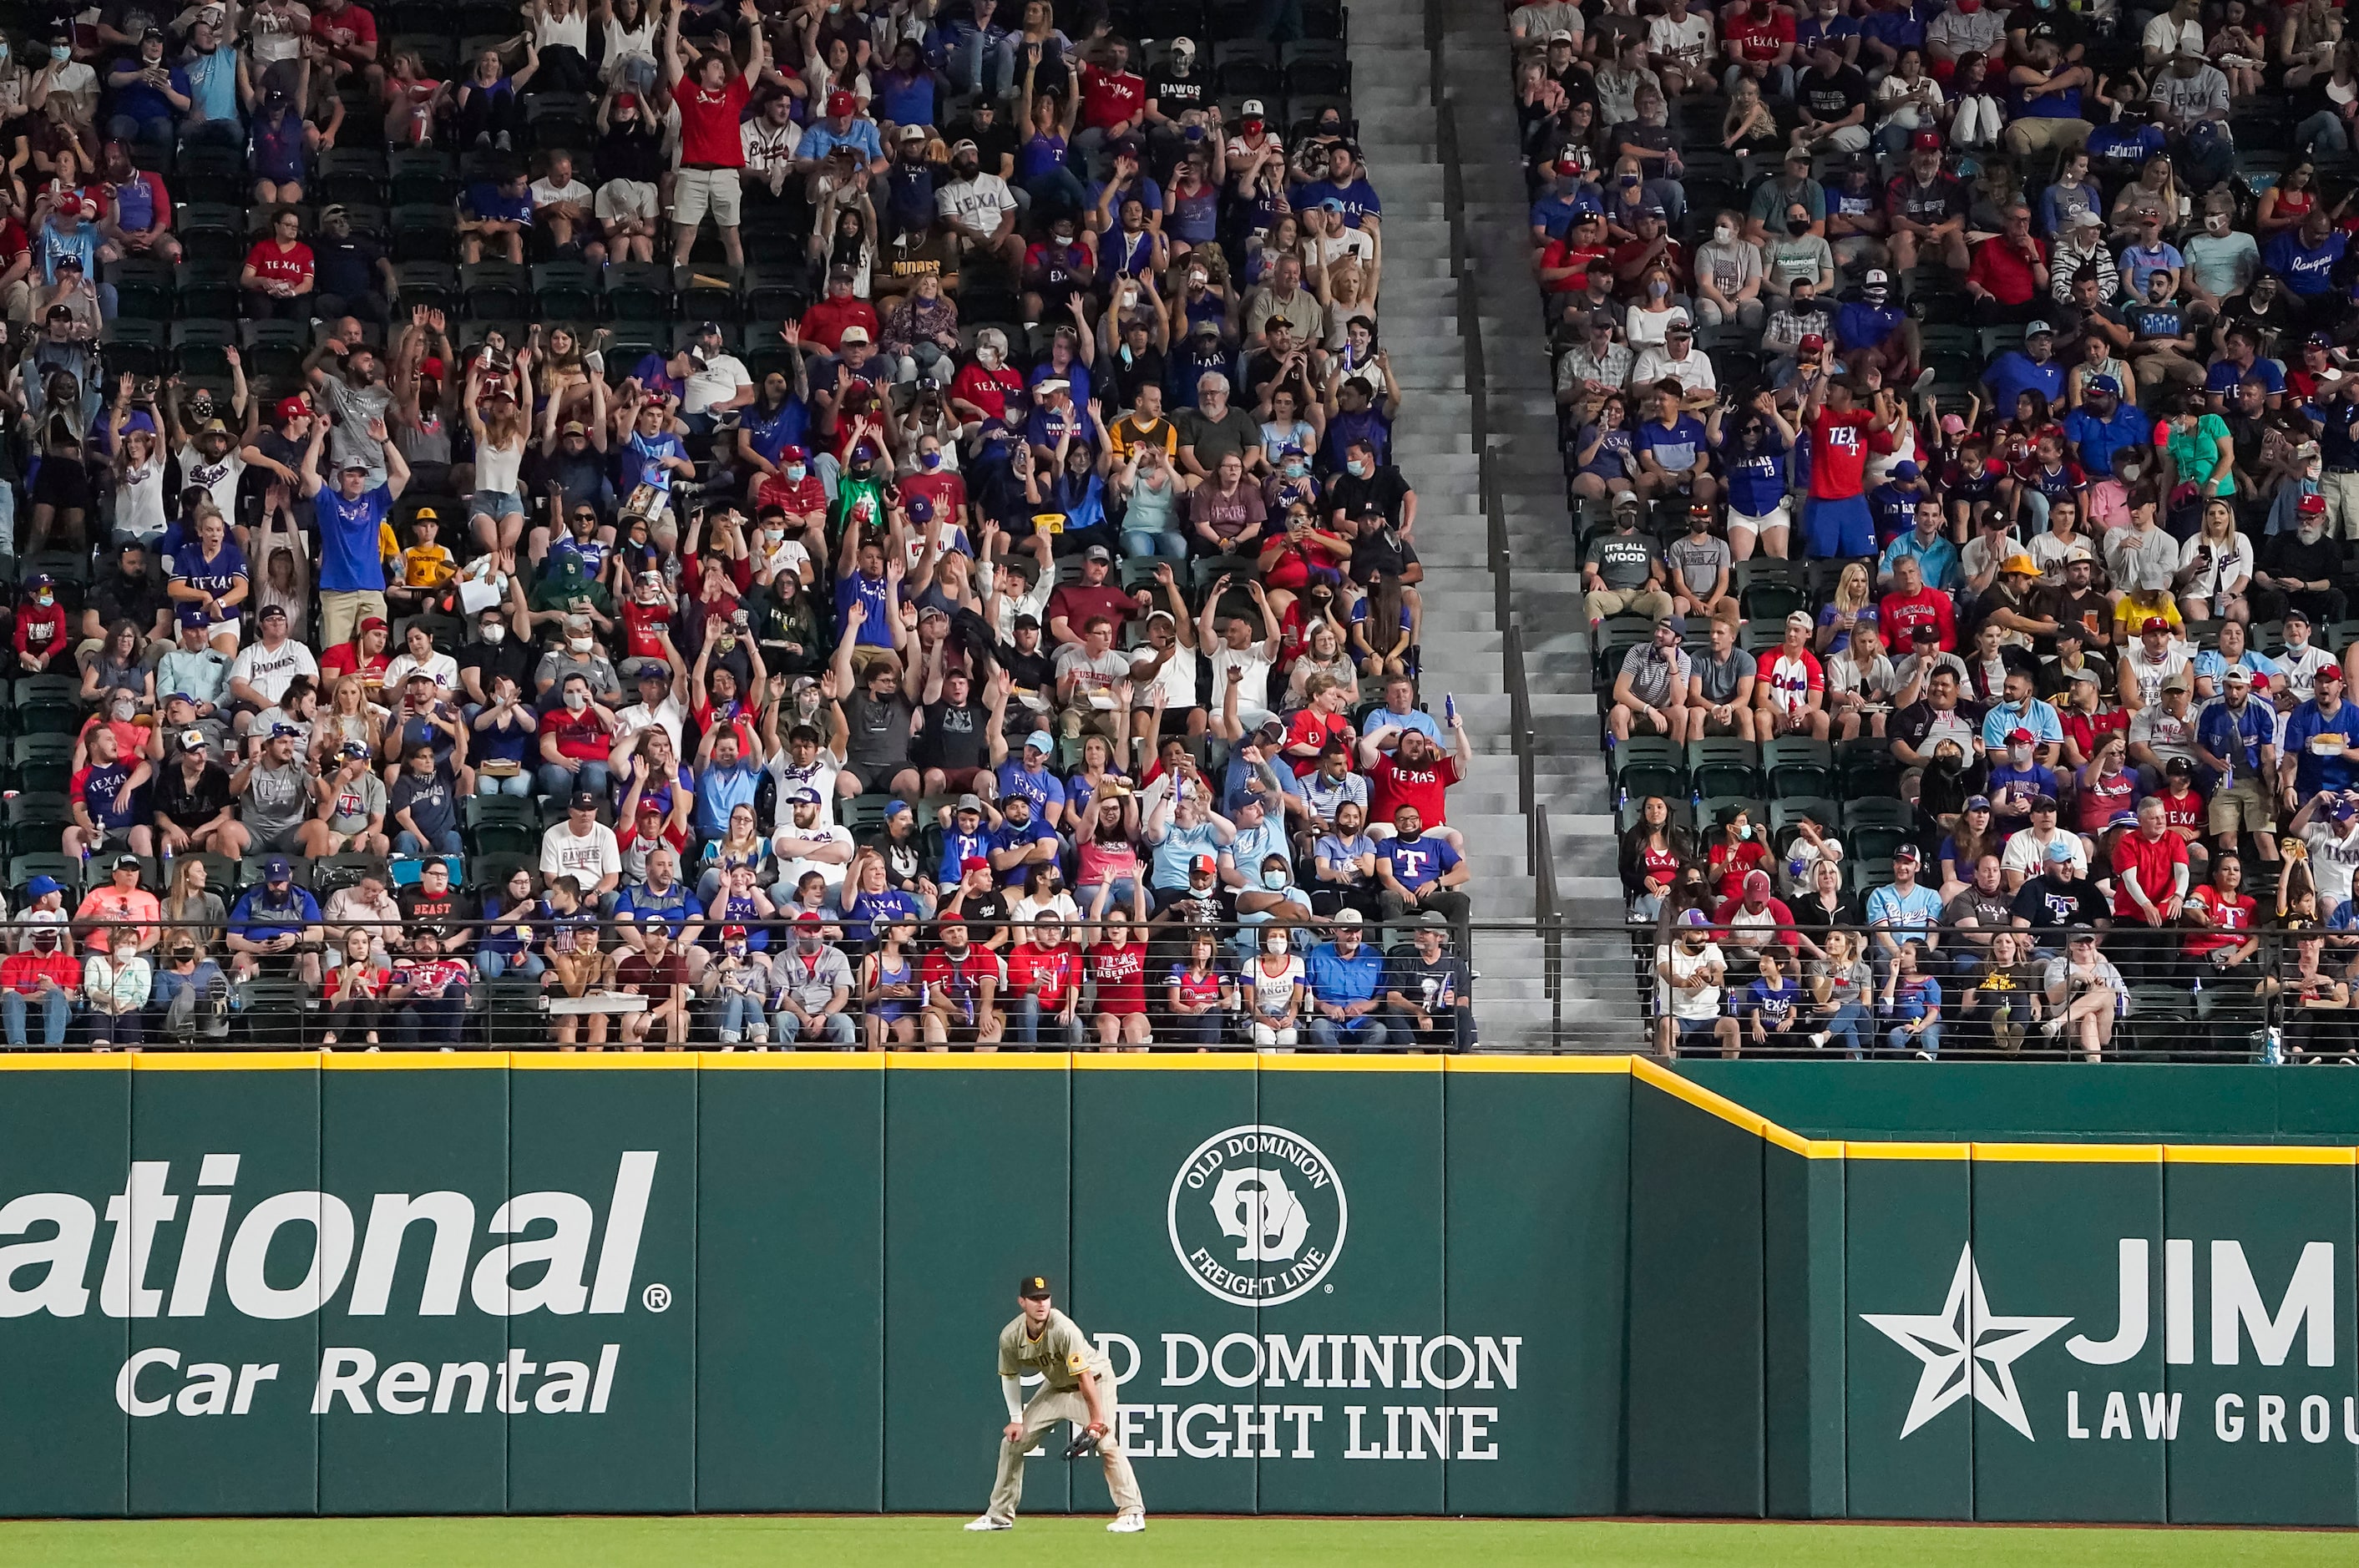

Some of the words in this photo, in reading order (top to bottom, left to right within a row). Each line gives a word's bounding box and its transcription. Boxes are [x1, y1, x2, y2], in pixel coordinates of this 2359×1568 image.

[1744, 37, 1780, 48] TEXAS
[1161, 84, 1201, 96] DAWGS
[838, 98, 845, 106] T
[1248, 102, 1258, 111] T
[2176, 93, 2207, 107] EXA
[1924, 134, 1932, 143] T
[840, 145, 849, 154] T
[1052, 149, 1063, 162] T
[909, 174, 916, 183] T
[956, 194, 1000, 210] TEXA
[1579, 201, 1588, 210] T
[1907, 198, 1944, 211] Ragers
[266, 260, 301, 273] TEXAS
[842, 264, 849, 272] T
[893, 260, 940, 276] PADRES
[1777, 258, 1816, 267] CHAMPIONS
[2291, 255, 2331, 272] Rangers
[1873, 272, 1882, 281] T
[2035, 321, 2044, 329] T
[2046, 369, 2053, 377] T
[484, 378, 501, 395] T
[342, 389, 352, 403] T
[1830, 427, 1855, 444] TEX
[792, 445, 800, 453] T
[1602, 436, 1631, 451] TEXA
[1848, 443, 1860, 456] T
[1764, 465, 1774, 477] 13
[941, 482, 952, 493] T
[802, 498, 807, 507] T
[1868, 535, 1876, 545] T
[1604, 543, 1625, 553] IT'S
[1626, 543, 1646, 552] ALL
[1605, 552, 1646, 563] WOOD
[1908, 615, 1916, 625] T
[2154, 617, 2162, 625] T
[252, 656, 296, 674] PADRES
[1080, 671, 1113, 682] USKERS
[1391, 766, 1436, 783] TEXAS
[89, 775, 127, 791] TEXAS
[261, 781, 271, 797] T
[2094, 782, 2132, 797] Rangers
[104, 787, 114, 797] T
[340, 794, 360, 816] T
[2335, 799, 2342, 807] T
[2164, 810, 2194, 824] EXA
[958, 837, 977, 859] T
[564, 850, 600, 861] RANGERS
[1396, 849, 1426, 877] T
[413, 903, 452, 915] BEAST
[726, 902, 759, 914] EXAS
[1885, 903, 1928, 921] Rangers
[2045, 894, 2078, 926] T
[582, 914, 591, 923] T
[1698, 913, 1705, 921] T
[2218, 905, 2245, 928] T
[1058, 953, 1068, 964] T
[1096, 965, 1142, 978] BASEBALL
[1114, 976, 1121, 984] T
[1187, 1149, 1223, 1190] OLD
[1226, 1135, 1329, 1190] DOMINION
[0, 1151, 659, 1319] ational
[1190, 1247, 1277, 1296] FREIGHT
[1280, 1247, 1326, 1291] LINE
[2065, 1238, 2335, 1368] JIM
[1161, 1333, 1522, 1389] DOMINION
[115, 1348, 279, 1417] Car
[310, 1343, 620, 1415] Rental
[2067, 1390, 2183, 1440] LAW
[1343, 1405, 1499, 1460] LINE
